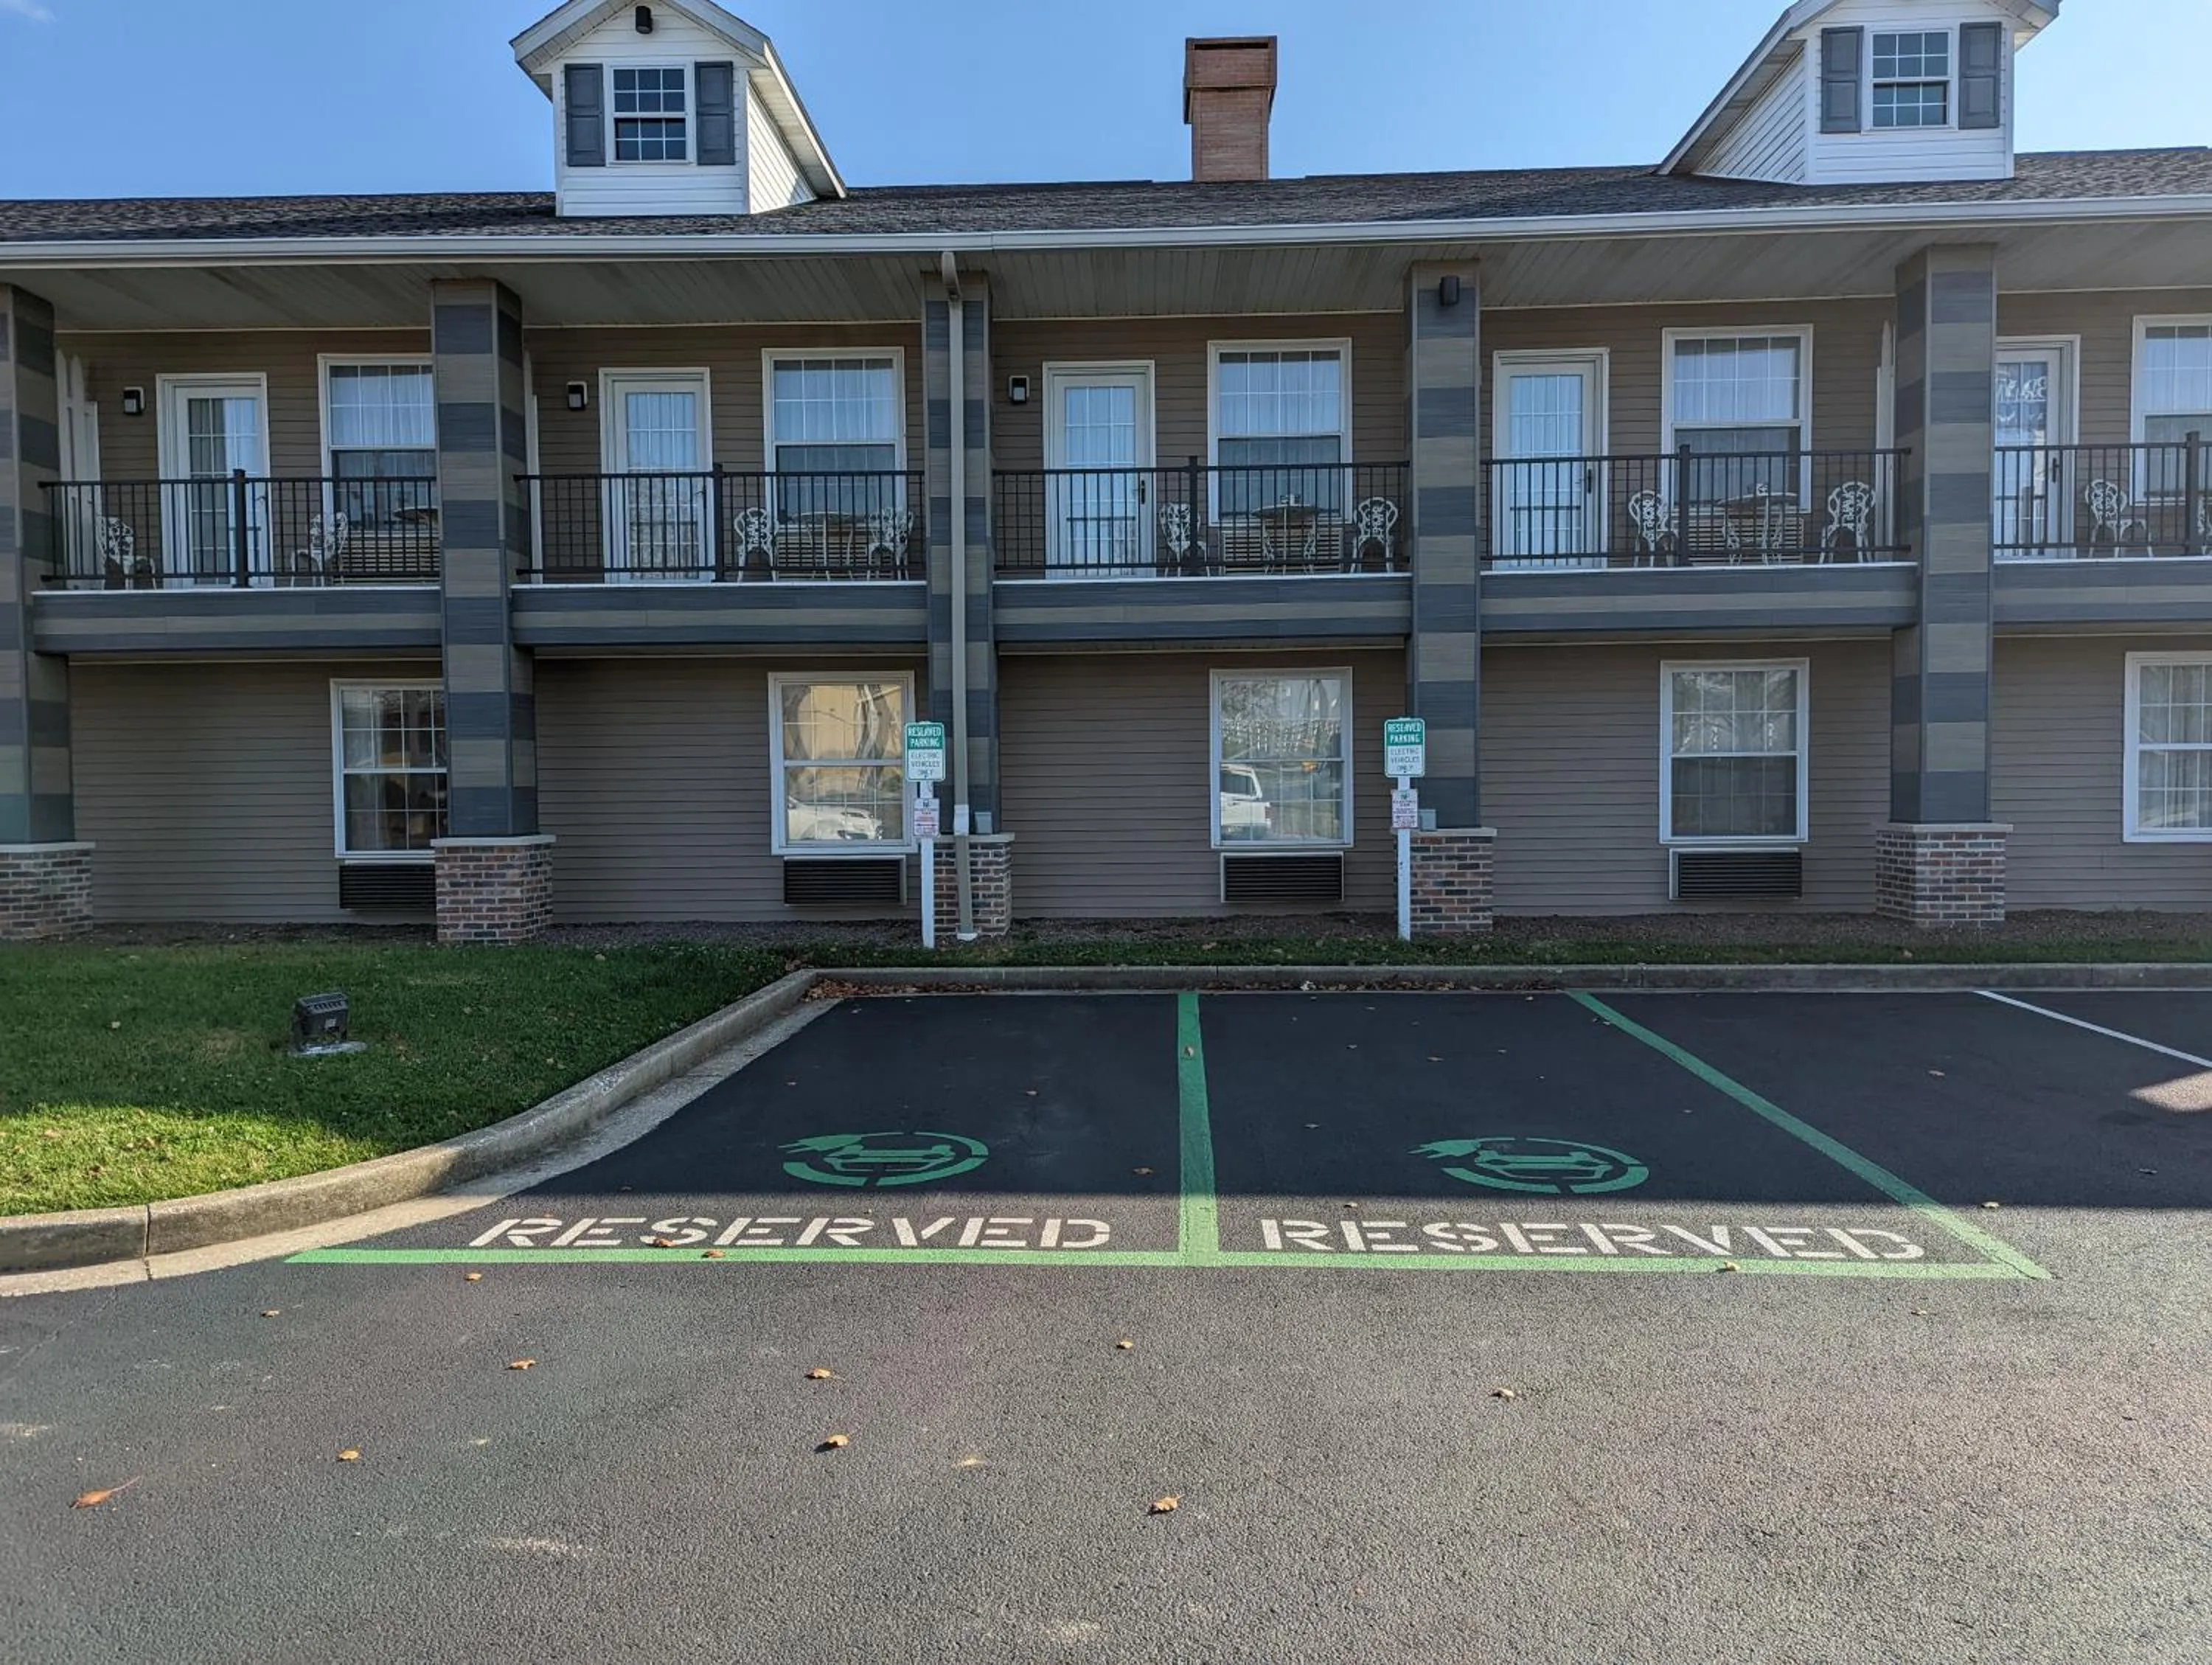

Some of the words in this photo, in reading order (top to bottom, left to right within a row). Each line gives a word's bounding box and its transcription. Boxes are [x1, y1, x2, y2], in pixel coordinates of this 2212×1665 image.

[1387, 723, 1422, 732] RESERVED
[910, 738, 940, 748] PARKING
[1390, 734, 1421, 743] PARKING
[468, 1217, 1112, 1249] RESERVED
[1260, 1218, 1925, 1259] RESERVED
